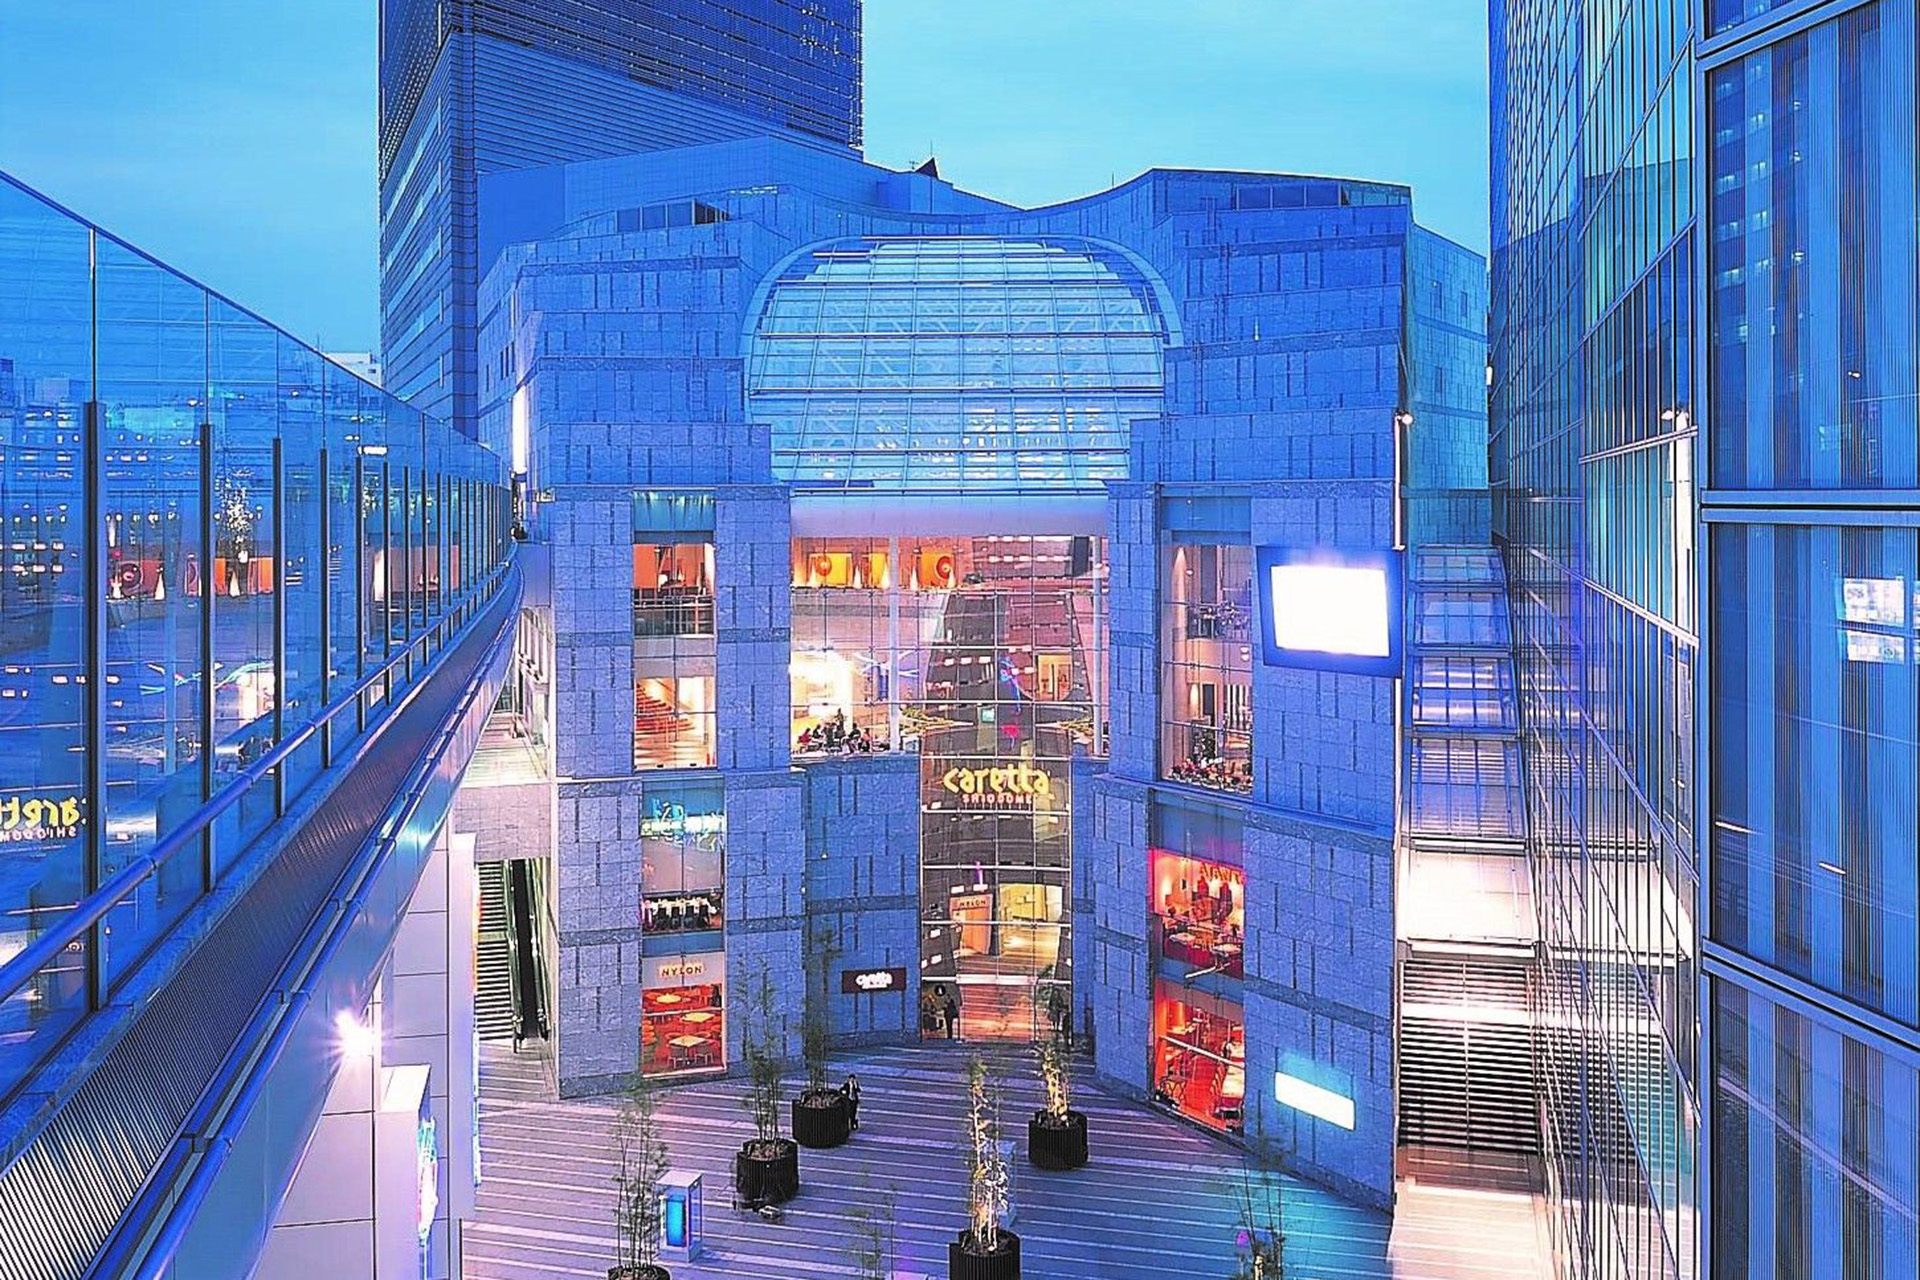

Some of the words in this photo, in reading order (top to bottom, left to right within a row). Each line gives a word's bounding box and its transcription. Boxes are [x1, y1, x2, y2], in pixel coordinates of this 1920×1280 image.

[944, 762, 1050, 795] caretta
[962, 793, 1033, 804] SHIODOME
[661, 966, 702, 976] NYLON
